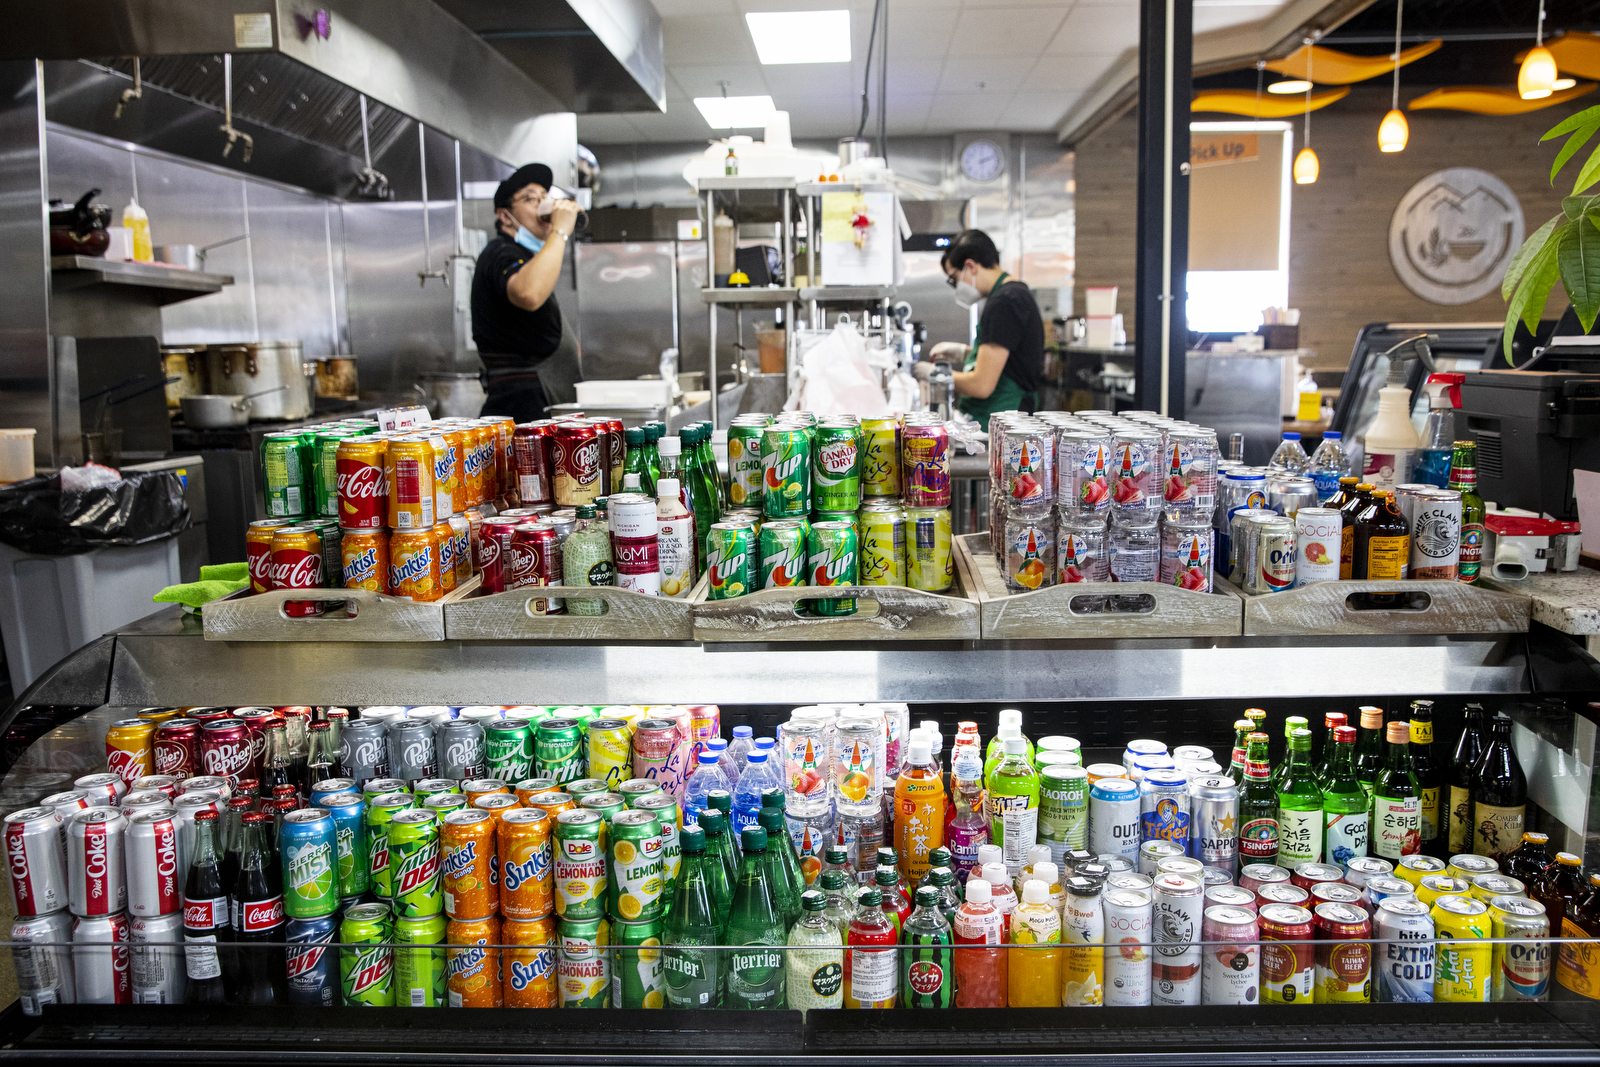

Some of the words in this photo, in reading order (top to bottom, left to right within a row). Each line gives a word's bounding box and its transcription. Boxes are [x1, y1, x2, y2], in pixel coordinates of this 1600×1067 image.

[1222, 142, 1246, 158] Up
[820, 443, 858, 465] CANADA
[831, 457, 852, 470] DRY
[863, 461, 888, 479] oix
[823, 491, 848, 499] GINGER
[1299, 524, 1341, 537] SOCIAL
[1415, 511, 1431, 539] WHITE
[1432, 509, 1459, 525] CLAW
[1420, 543, 1439, 556] HARD
[1440, 531, 1459, 556] SELTZER
[1270, 545, 1298, 565] Orio
[390, 546, 432, 586] Sunkist
[862, 556, 885, 575] oix
[355, 568, 376, 583] Orange
[219, 742, 240, 760] Dr
[462, 737, 480, 751] Dr
[155, 750, 181, 771] epper
[208, 746, 250, 775] Pepper
[360, 742, 387, 766] Pepp
[407, 742, 435, 767] Pepp
[377, 765, 390, 775] TE
[425, 765, 438, 775] TE
[535, 757, 584, 783] Sprite
[1040, 787, 1084, 801] HAOKOH
[1422, 791, 1437, 802] AJ
[737, 813, 758, 825] AQUA
[1383, 813, 1418, 829] 순하리
[1112, 823, 1140, 839] OUTL
[1144, 820, 1189, 842] Tiger
[1282, 824, 1312, 841] 처음
[568, 843, 592, 853] Dole
[645, 839, 662, 852] Dole
[950, 839, 979, 855] Ramu
[1122, 838, 1139, 846] ENE
[1200, 837, 1239, 850] SAPPO
[1282, 838, 1312, 853] 처럼
[8, 833, 28, 879] Coke
[86, 832, 107, 878] Coke
[158, 830, 176, 876] Coke
[289, 842, 329, 869] SIERRA
[289, 849, 331, 888] MIST
[453, 864, 476, 880] Orange
[556, 866, 606, 880] LEMONADE
[626, 861, 663, 881] LEMONA
[908, 868, 929, 876] Hojic
[14, 879, 28, 900] Diet
[91, 878, 103, 899] Diet
[164, 876, 174, 897] Diet
[1160, 902, 1191, 922] CLAW
[1110, 916, 1151, 931] SOCIA
[1341, 956, 1365, 964] TAIWAN
[1387, 943, 1435, 963] EXTRA
[1510, 943, 1549, 962] Orio
[462, 962, 485, 979] Orange
[557, 965, 604, 978] LEMONADE
[1263, 960, 1280, 970] BEER
[1344, 963, 1363, 971] BEER
[1391, 962, 1432, 981] COLD
[911, 971, 939, 984] スイカ
[1222, 971, 1240, 980] Sweet
[1240, 971, 1255, 979] Touch
